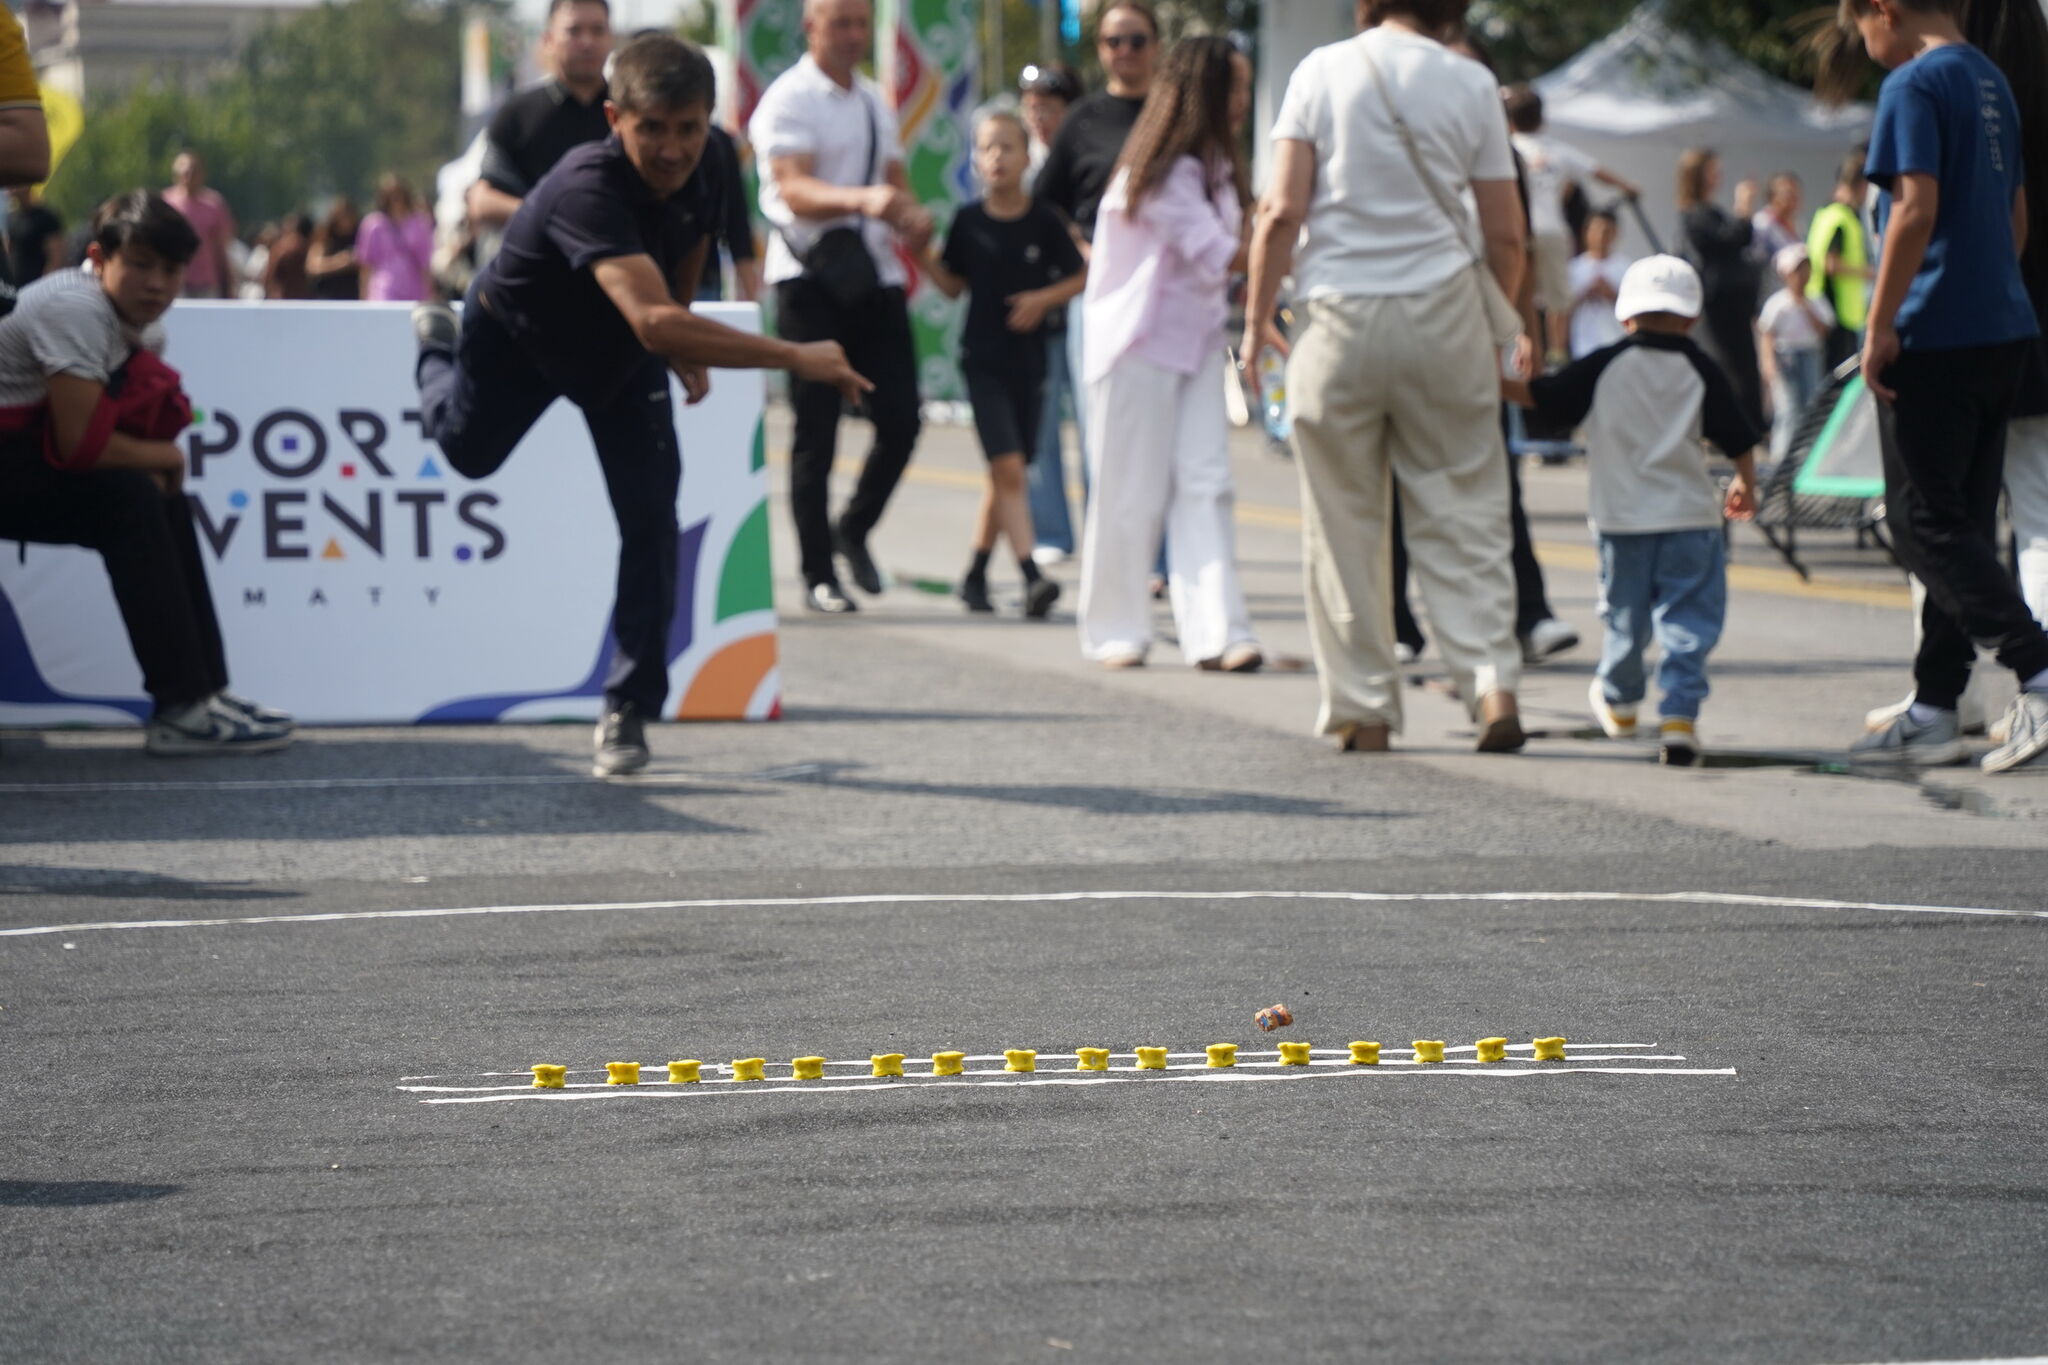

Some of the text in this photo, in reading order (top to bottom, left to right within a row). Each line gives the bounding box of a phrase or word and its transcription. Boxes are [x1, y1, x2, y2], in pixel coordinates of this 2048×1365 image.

[189, 408, 441, 478] PORT
[186, 490, 505, 561] VENTS
[243, 587, 439, 607] MATY
